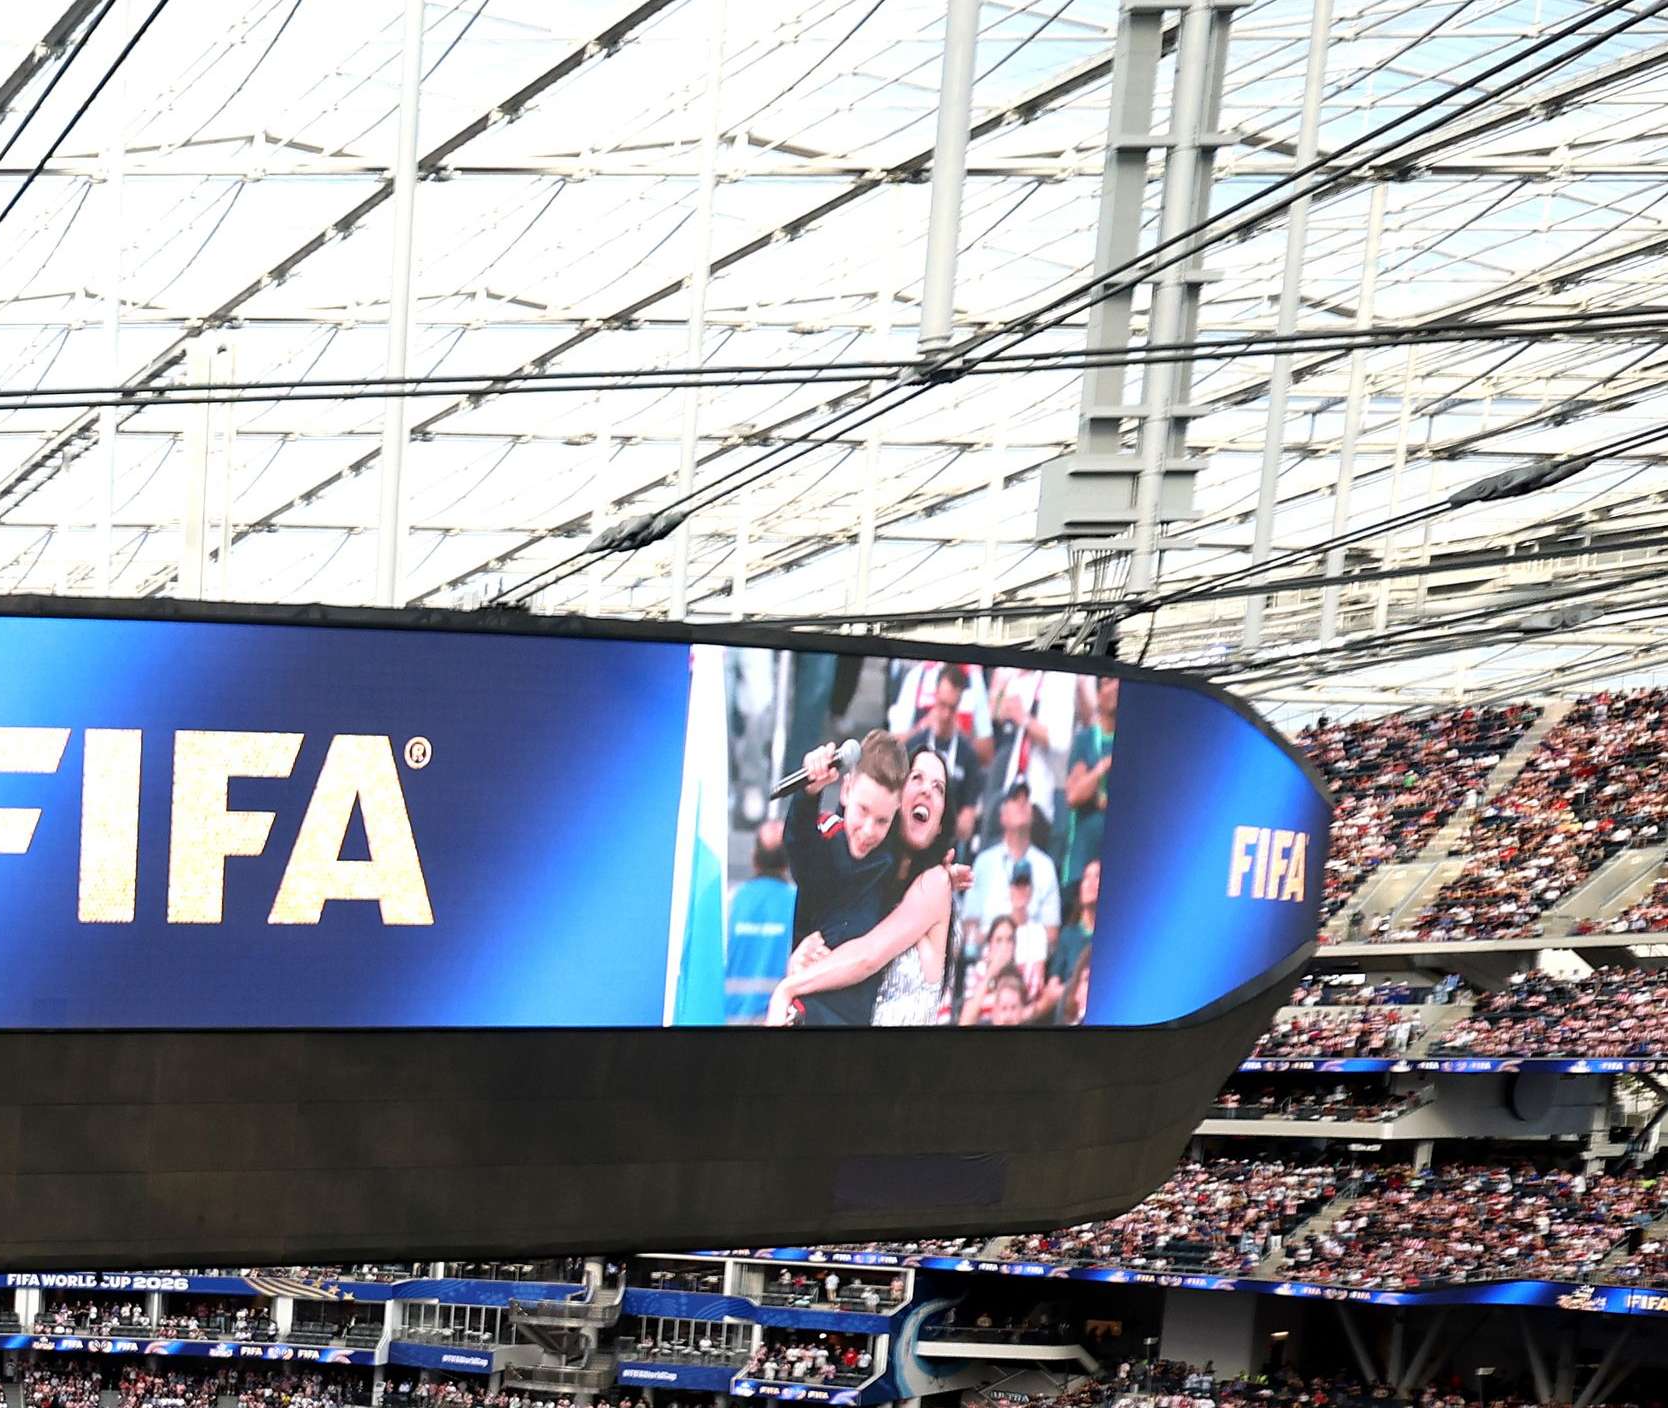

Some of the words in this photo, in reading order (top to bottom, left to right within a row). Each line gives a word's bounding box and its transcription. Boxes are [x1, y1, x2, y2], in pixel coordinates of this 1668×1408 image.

[7, 1273, 40, 1286] FIFA
[41, 1274, 97, 1287] WORLD
[133, 1277, 189, 1290] 2026
[64, 1339, 83, 1349] FIFA
[759, 1385, 779, 1395] FIFA
